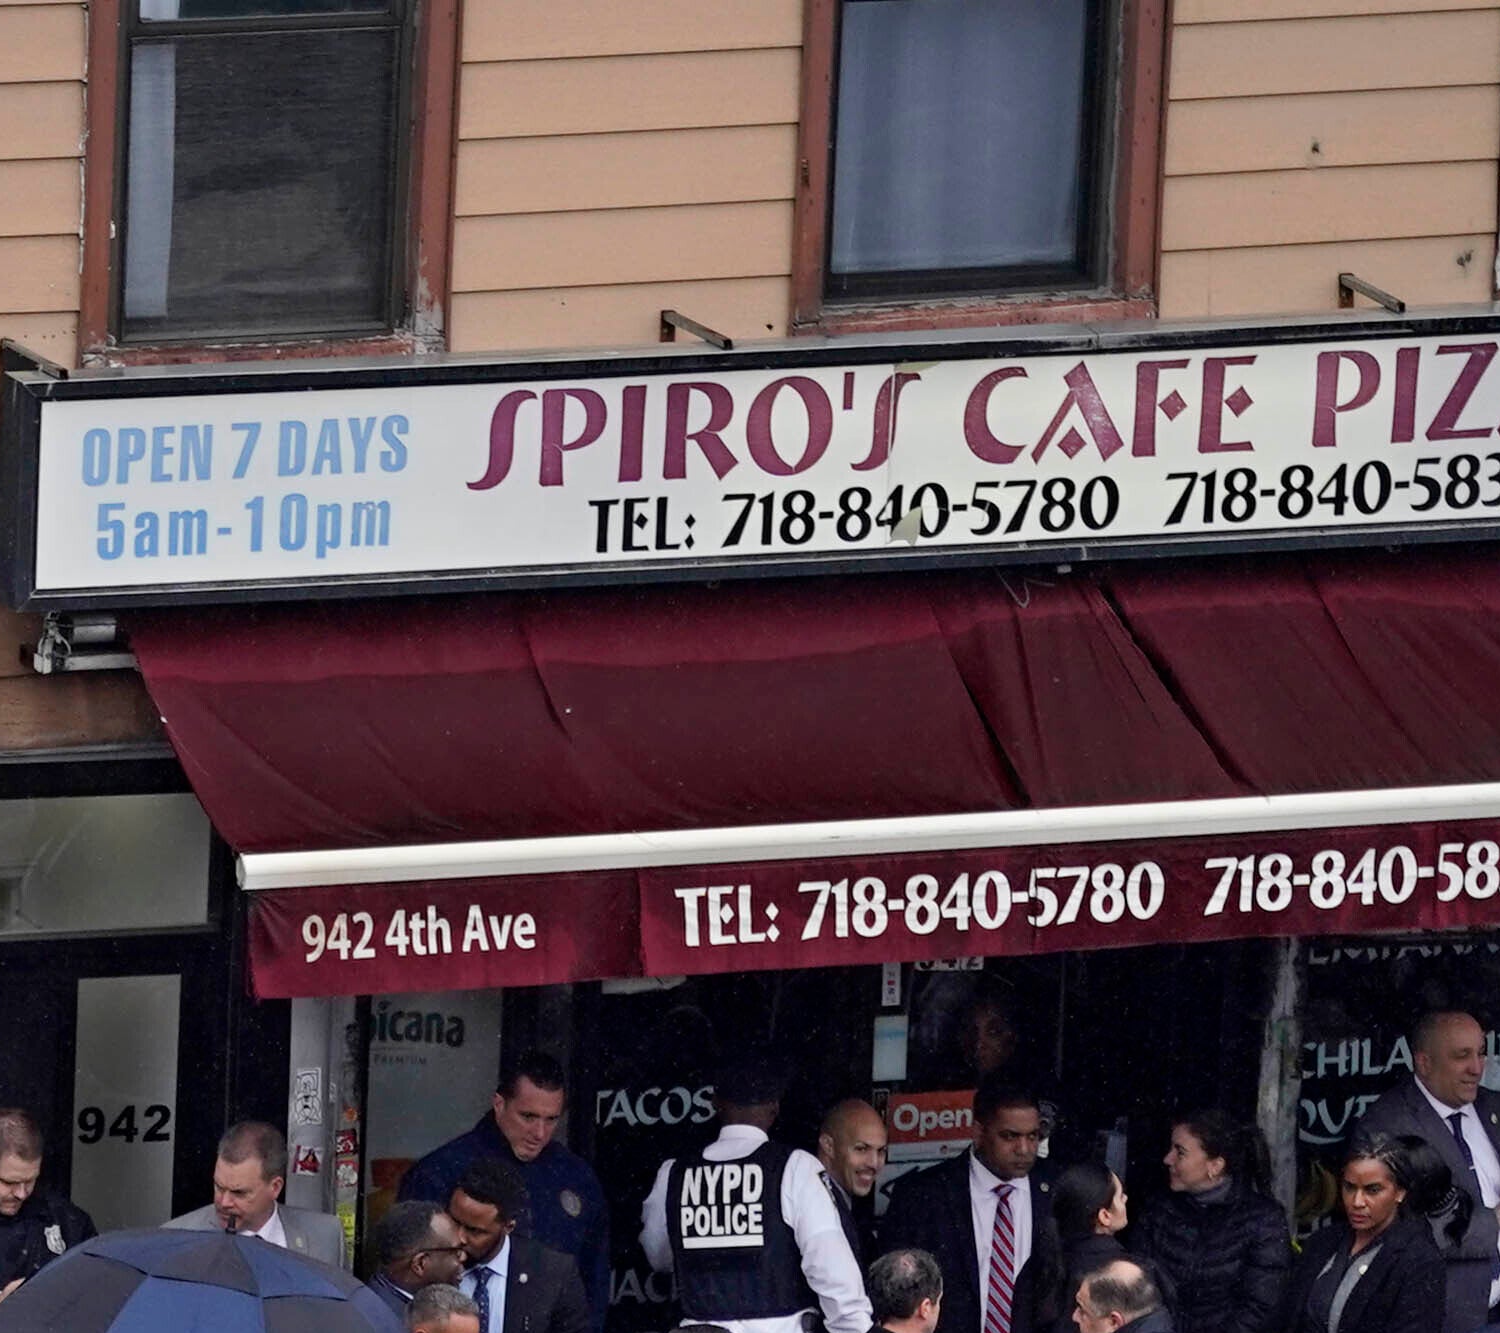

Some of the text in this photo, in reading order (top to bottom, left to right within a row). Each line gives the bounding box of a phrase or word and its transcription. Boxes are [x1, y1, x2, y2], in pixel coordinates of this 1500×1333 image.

[81, 414, 410, 488] OPEN 7 DAYS
[466, 369, 922, 492] SPIRO'S
[962, 355, 1259, 466] CAFE
[94, 493, 393, 562] 5am-10pm
[588, 496, 695, 554] TEL:
[720, 474, 1120, 549] 718-840-5780
[674, 884, 780, 947] TEL:
[798, 859, 1164, 942] 718-840-5780
[302, 907, 536, 964] 942 4th Ave
[78, 1104, 172, 1145] 942
[596, 1085, 718, 1128] TACOS
[894, 1103, 973, 1136] Open
[681, 1164, 763, 1205] NYPD
[681, 1203, 763, 1237] POLICE
